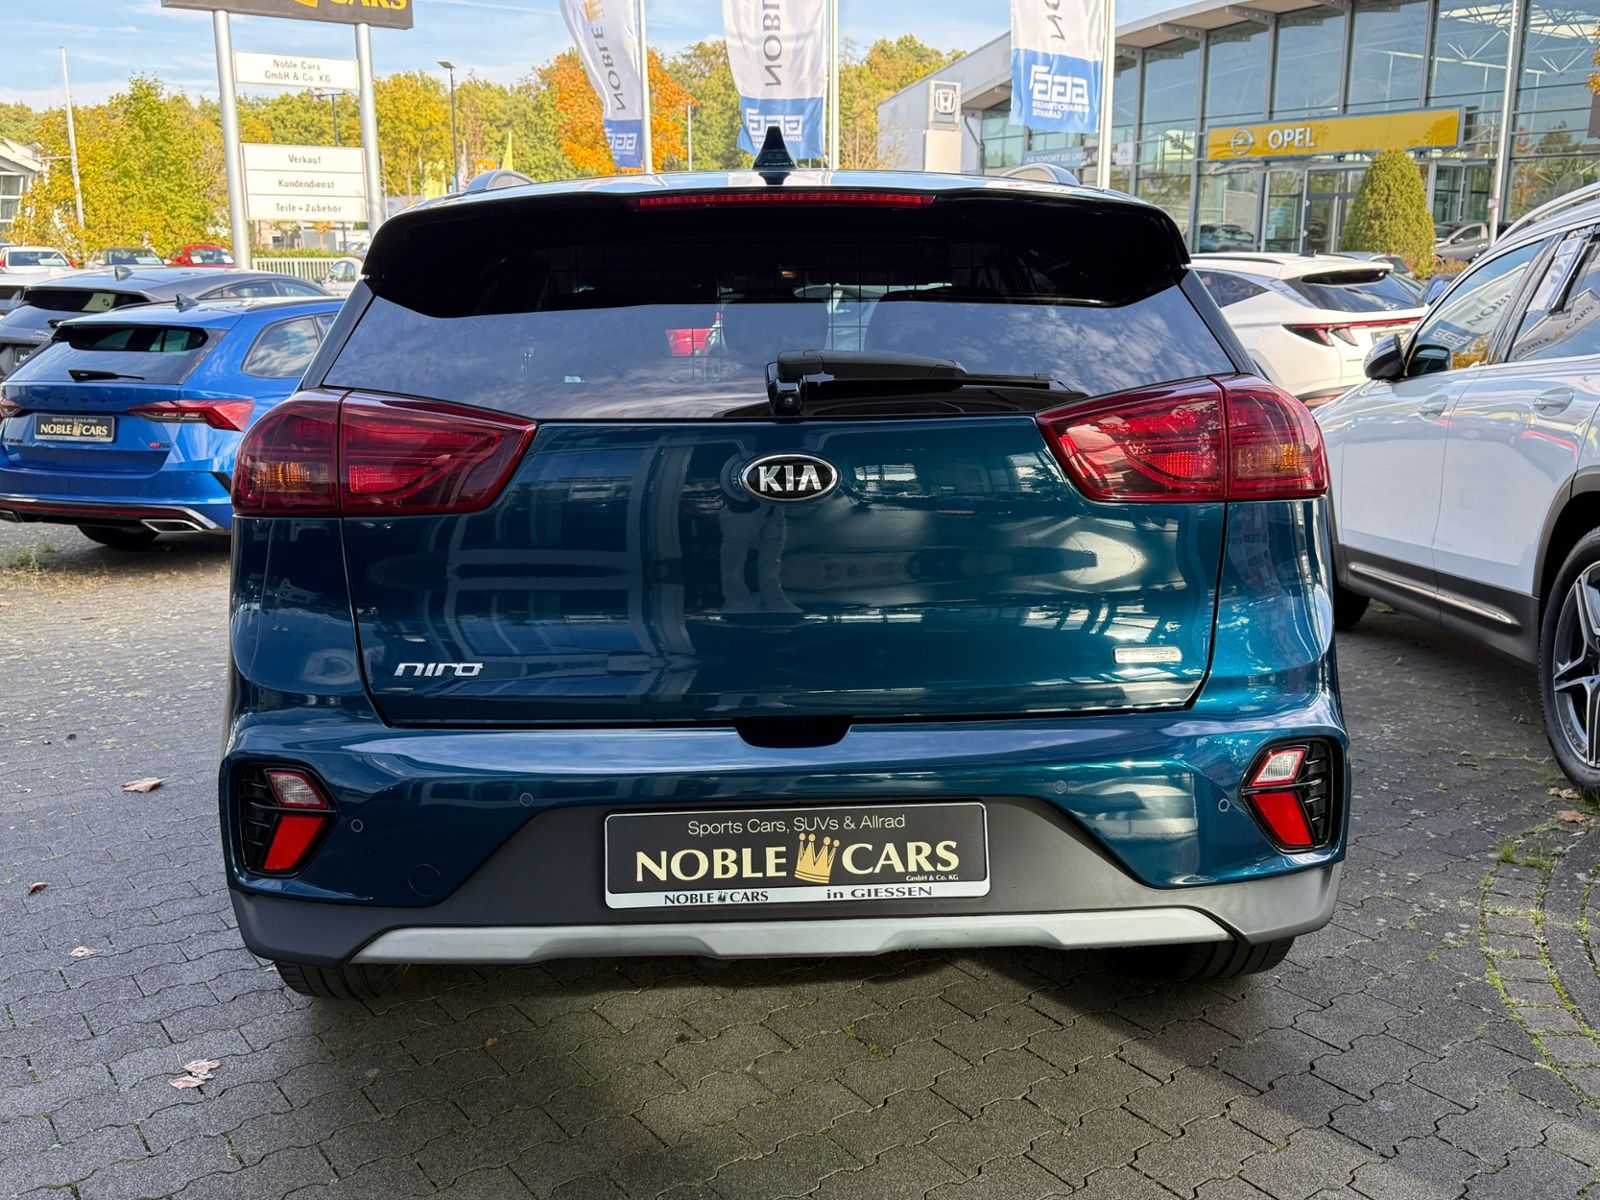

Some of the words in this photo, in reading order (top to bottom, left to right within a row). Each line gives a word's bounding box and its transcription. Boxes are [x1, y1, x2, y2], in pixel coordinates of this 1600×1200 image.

[273, 59, 298, 69] Noble
[301, 61, 321, 71] Cars
[264, 70, 290, 80] GmbH
[293, 72, 299, 81] &
[319, 74, 331, 83] KG
[1268, 127, 1316, 150] OPEL
[288, 154, 322, 164] Verkauf
[278, 179, 335, 189] Kundendienst
[276, 203, 297, 212] Teile
[40, 423, 72, 435] NOBLE
[82, 425, 108, 436] CARS
[758, 465, 822, 492] KIA
[688, 820, 743, 838] Sports
[747, 818, 790, 834] Cars,
[793, 816, 839, 832] SUVs
[843, 816, 856, 830] &
[859, 814, 906, 829] Allrad
[636, 846, 787, 882] NOBLE
[841, 840, 960, 875] CARS
[949, 873, 959, 881] KG
[664, 892, 714, 905] NOBLE
[729, 890, 769, 903] CARS
[827, 889, 844, 899] in
[850, 886, 932, 898] GIESSEN
